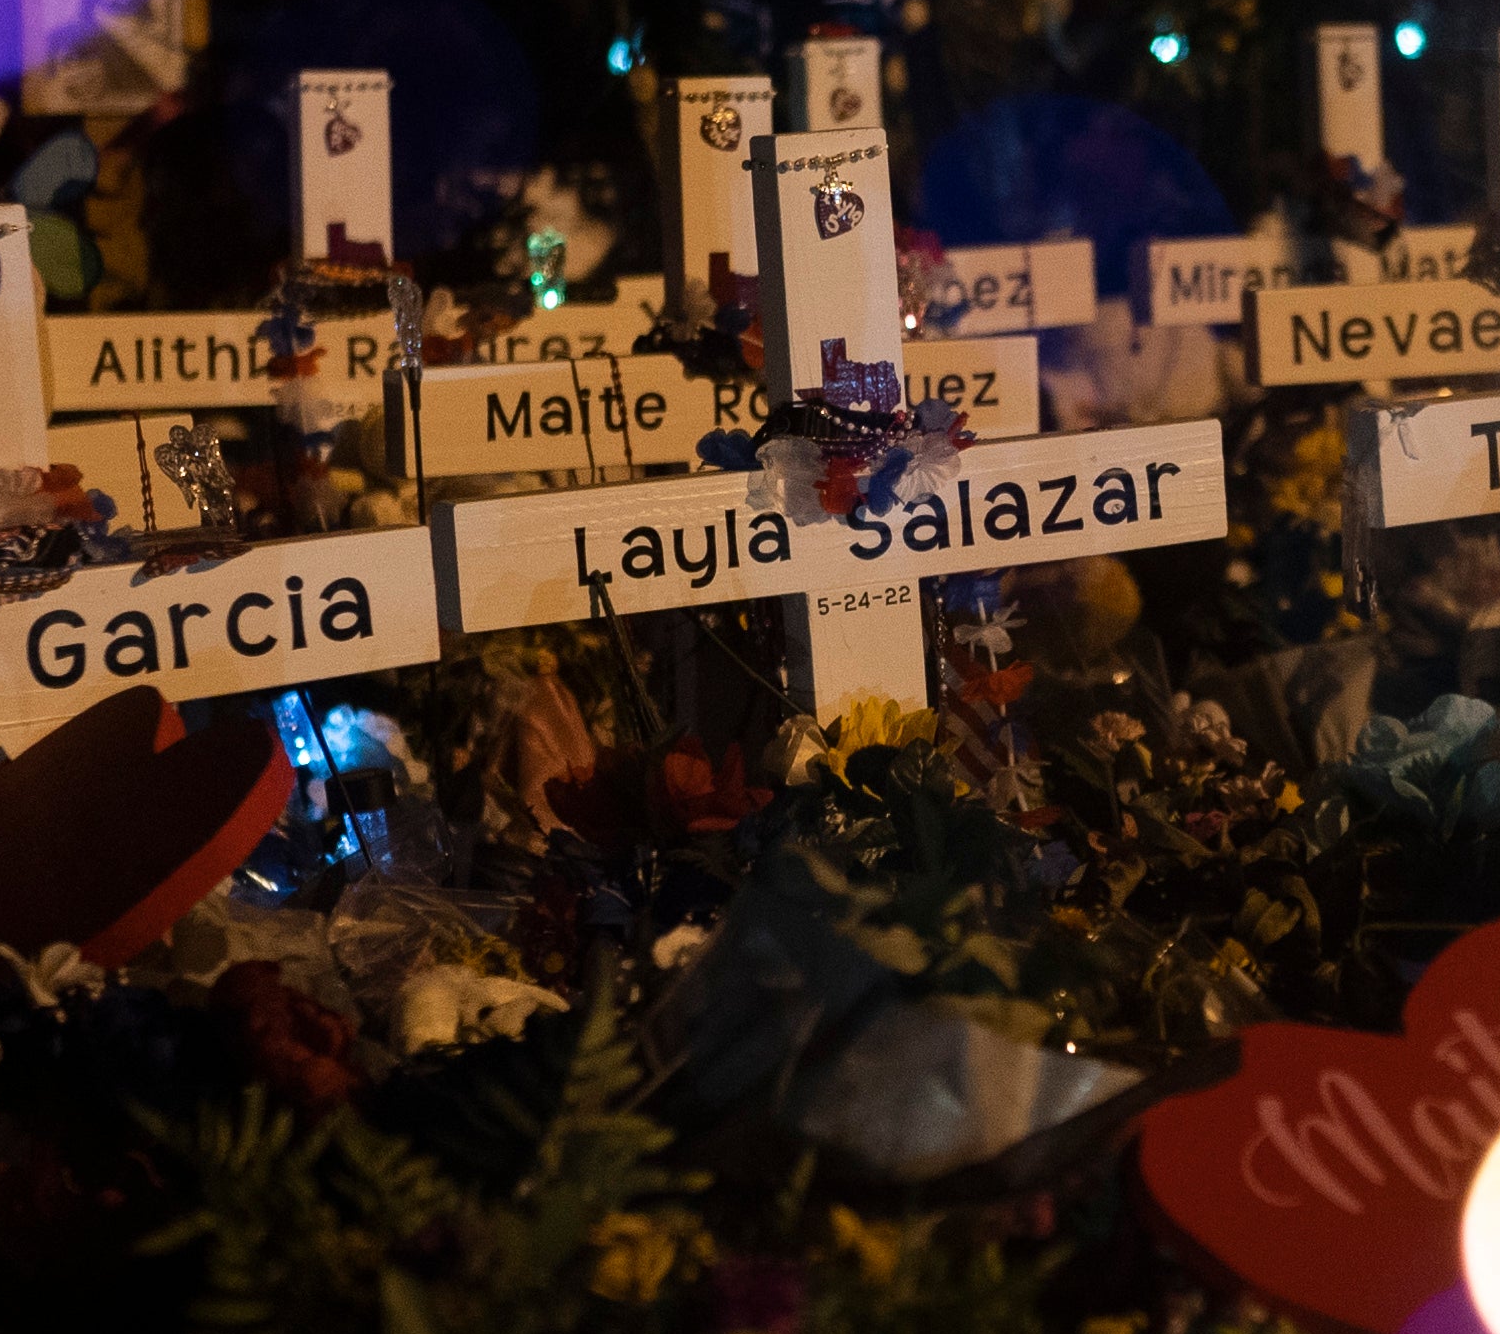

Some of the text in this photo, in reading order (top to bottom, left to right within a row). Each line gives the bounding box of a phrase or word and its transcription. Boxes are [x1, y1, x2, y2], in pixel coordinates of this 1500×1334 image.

[486, 389, 667, 442] Maite
[573, 460, 1182, 589] Layla Salazar
[27, 574, 374, 690] Garcia
[816, 586, 913, 617] 5-24-22
